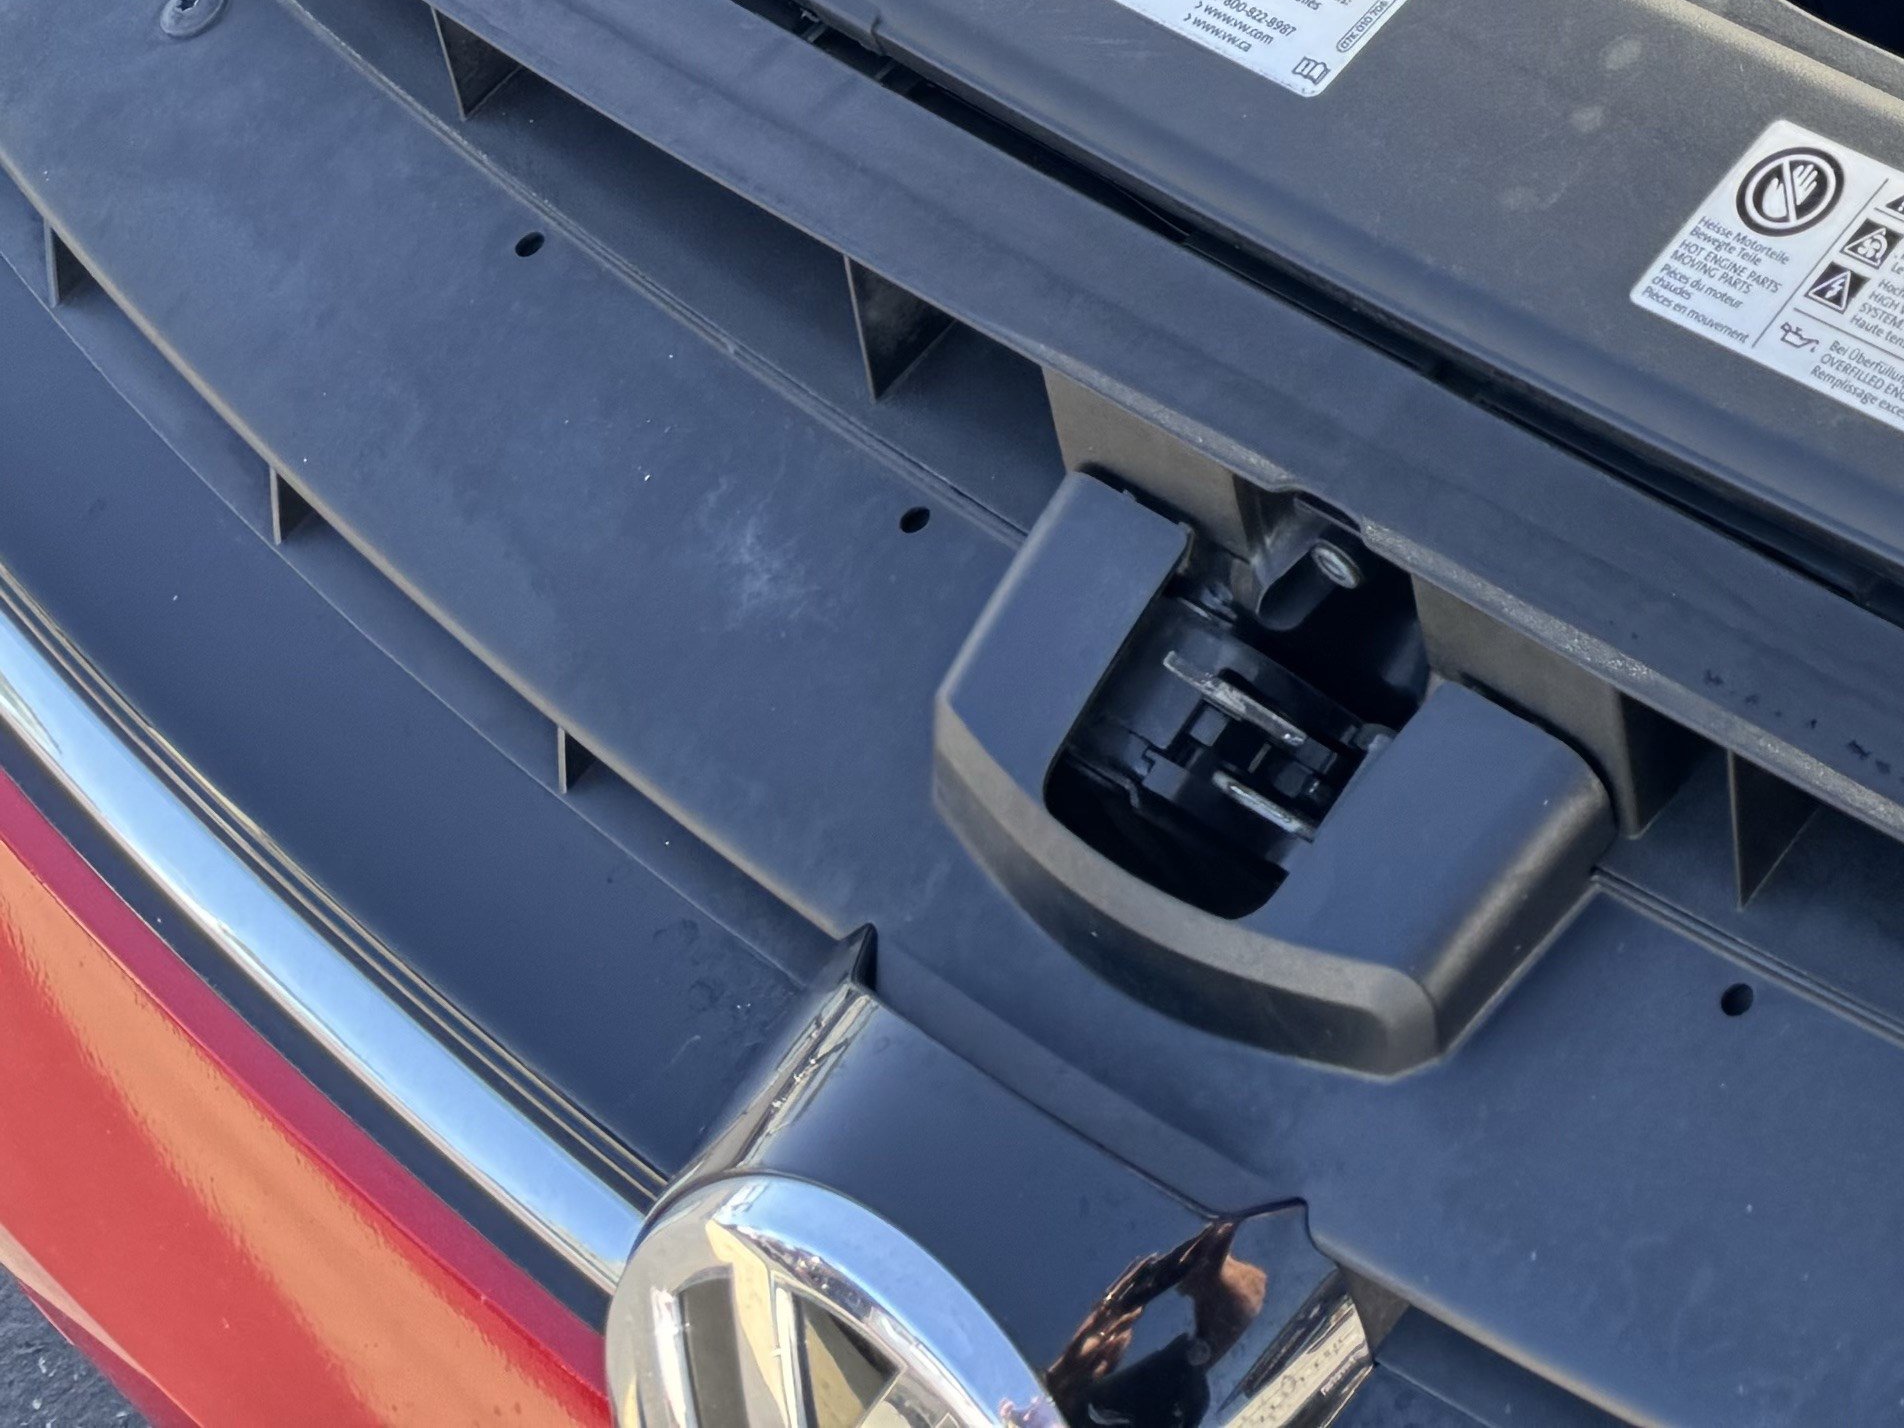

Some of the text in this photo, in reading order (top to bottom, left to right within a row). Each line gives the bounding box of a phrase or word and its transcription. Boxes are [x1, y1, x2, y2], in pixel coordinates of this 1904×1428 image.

[1688, 224, 1762, 267] Bewegte Teile
[1696, 214, 1790, 265] Heisse Motorteile
[1669, 248, 1753, 295] MOVING PARTS
[1677, 238, 1783, 294] HOT ENGINE PARTS
[1889, 260, 1904, 276] Le
[1688, 277, 1706, 292] du
[1703, 285, 1744, 309] moteur
[1867, 289, 1901, 311] HIGH
[1685, 308, 1750, 344] mouvement
[1848, 313, 1885, 337] Haute
[1827, 338, 1849, 356] Bei
[1809, 364, 1879, 405] Remplissage
[1819, 352, 1885, 390] OVERFILLED
